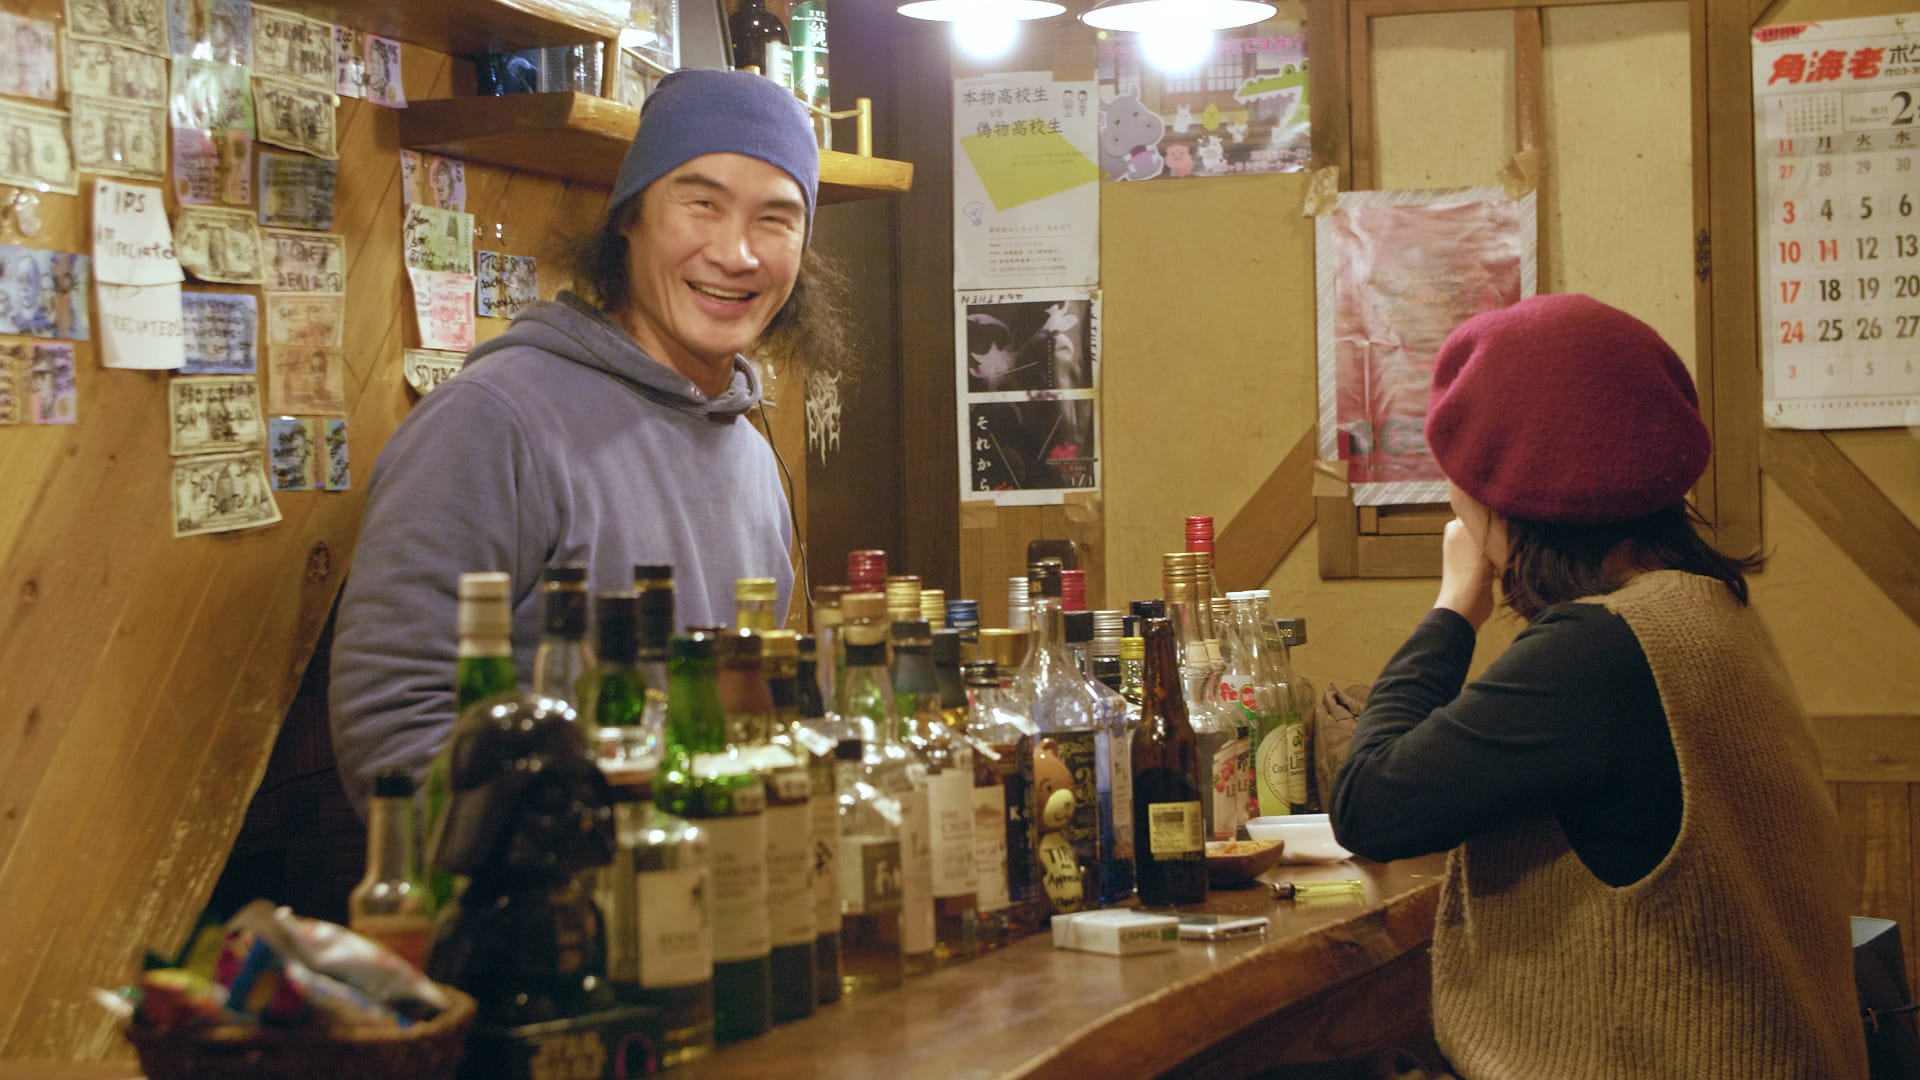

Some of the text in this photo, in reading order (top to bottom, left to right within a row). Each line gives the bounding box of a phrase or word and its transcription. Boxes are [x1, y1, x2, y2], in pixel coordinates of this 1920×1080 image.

[1768, 46, 1886, 86] 角海老
[962, 86, 1049, 108] 本物高校生
[1891, 91, 1914, 126] 2
[976, 117, 1063, 138] 偽物高校生
[1856, 133, 1872, 147] 火
[1895, 130, 1911, 144] 水
[1779, 164, 1795, 179] 27
[1857, 160, 1872, 175] 29
[1895, 157, 1911, 172] 30
[1782, 194, 1912, 224] 3 4 5 6
[1779, 235, 1918, 264] 10 11 12 13
[1780, 275, 1920, 304] 17 18 19 20
[1780, 315, 1920, 345] 24 25 26 27
[975, 416, 992, 491] それから
